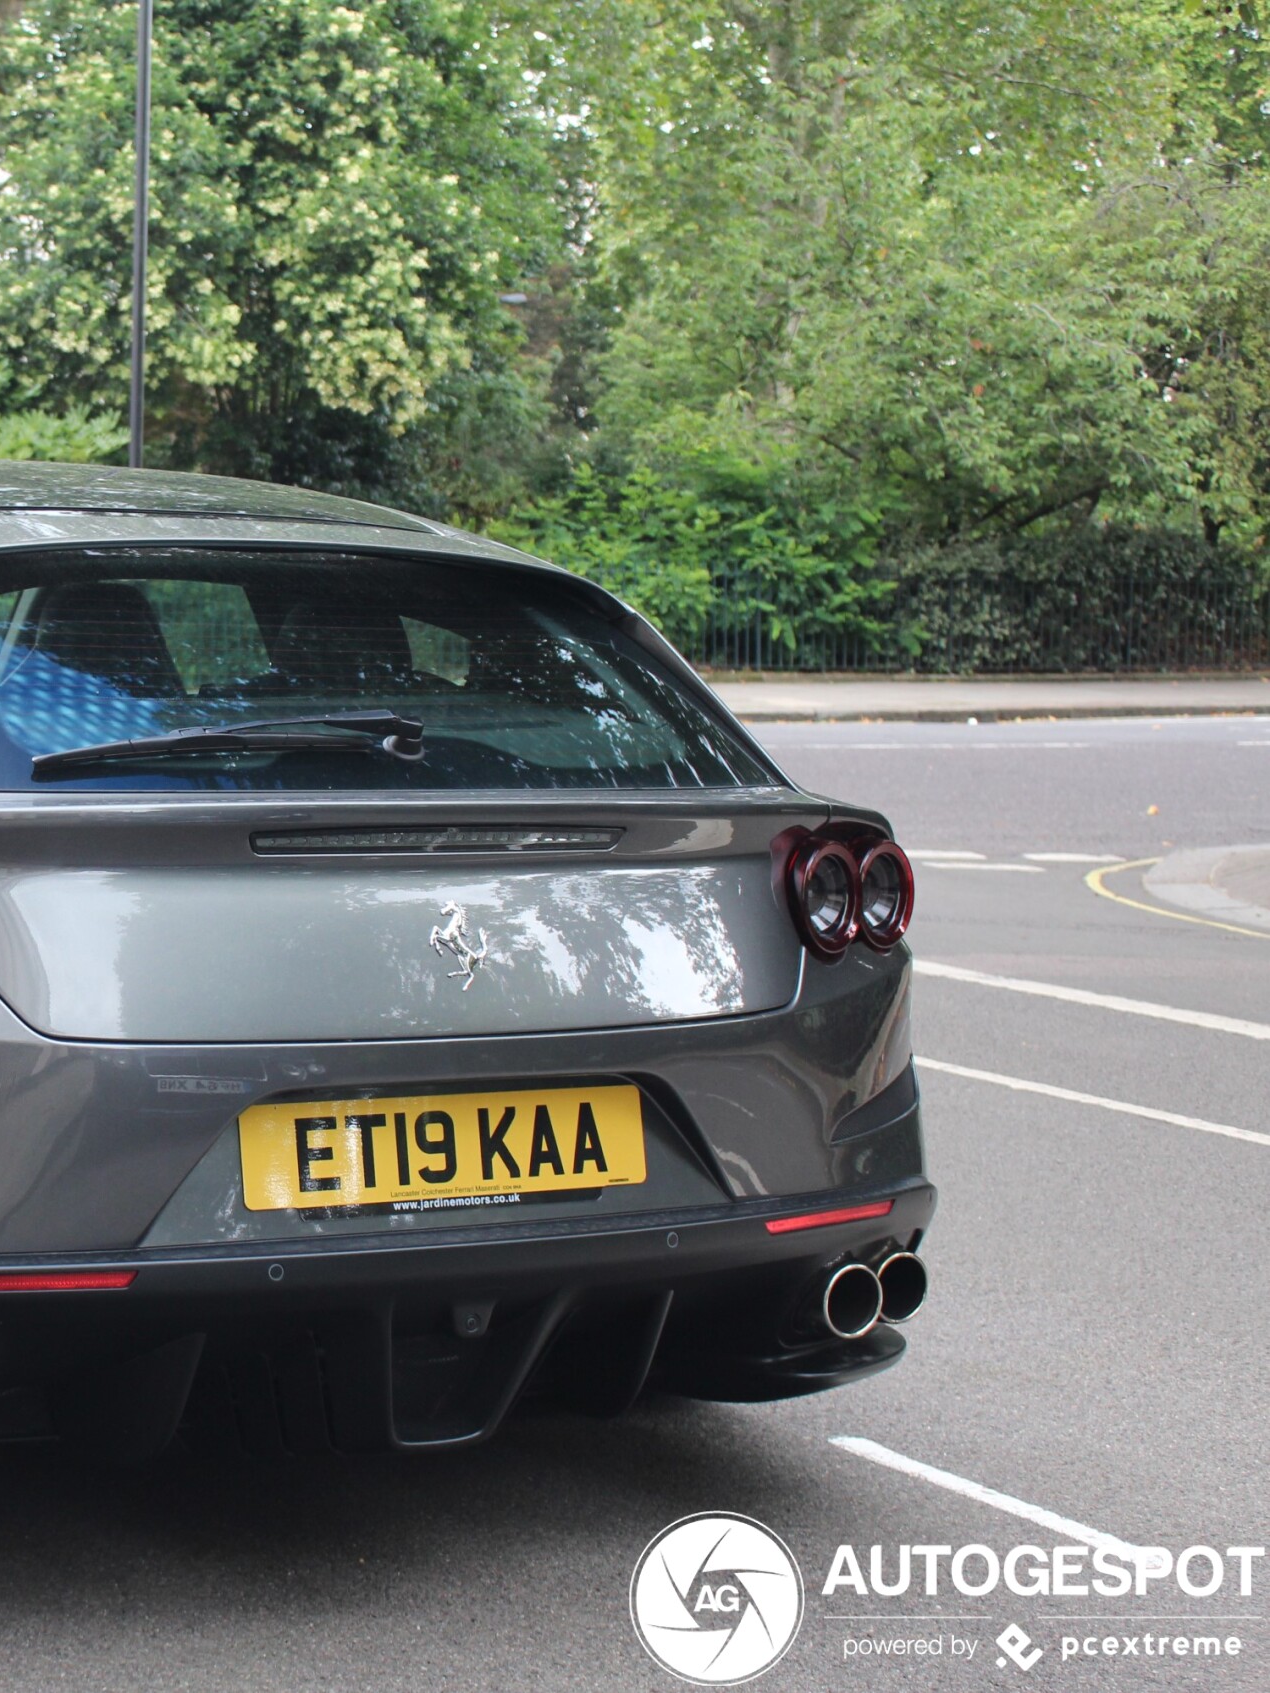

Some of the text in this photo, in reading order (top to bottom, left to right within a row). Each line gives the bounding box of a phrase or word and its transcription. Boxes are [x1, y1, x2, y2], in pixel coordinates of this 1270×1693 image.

[294, 1101, 609, 1193] ET19 KAA
[390, 1188, 421, 1198] Lancaster
[421, 1187, 453, 1196] Colchester
[455, 1185, 474, 1194] Ferrari
[475, 1184, 500, 1192] Maserati
[392, 1193, 521, 1211] www.jardinemotors.co.uk
